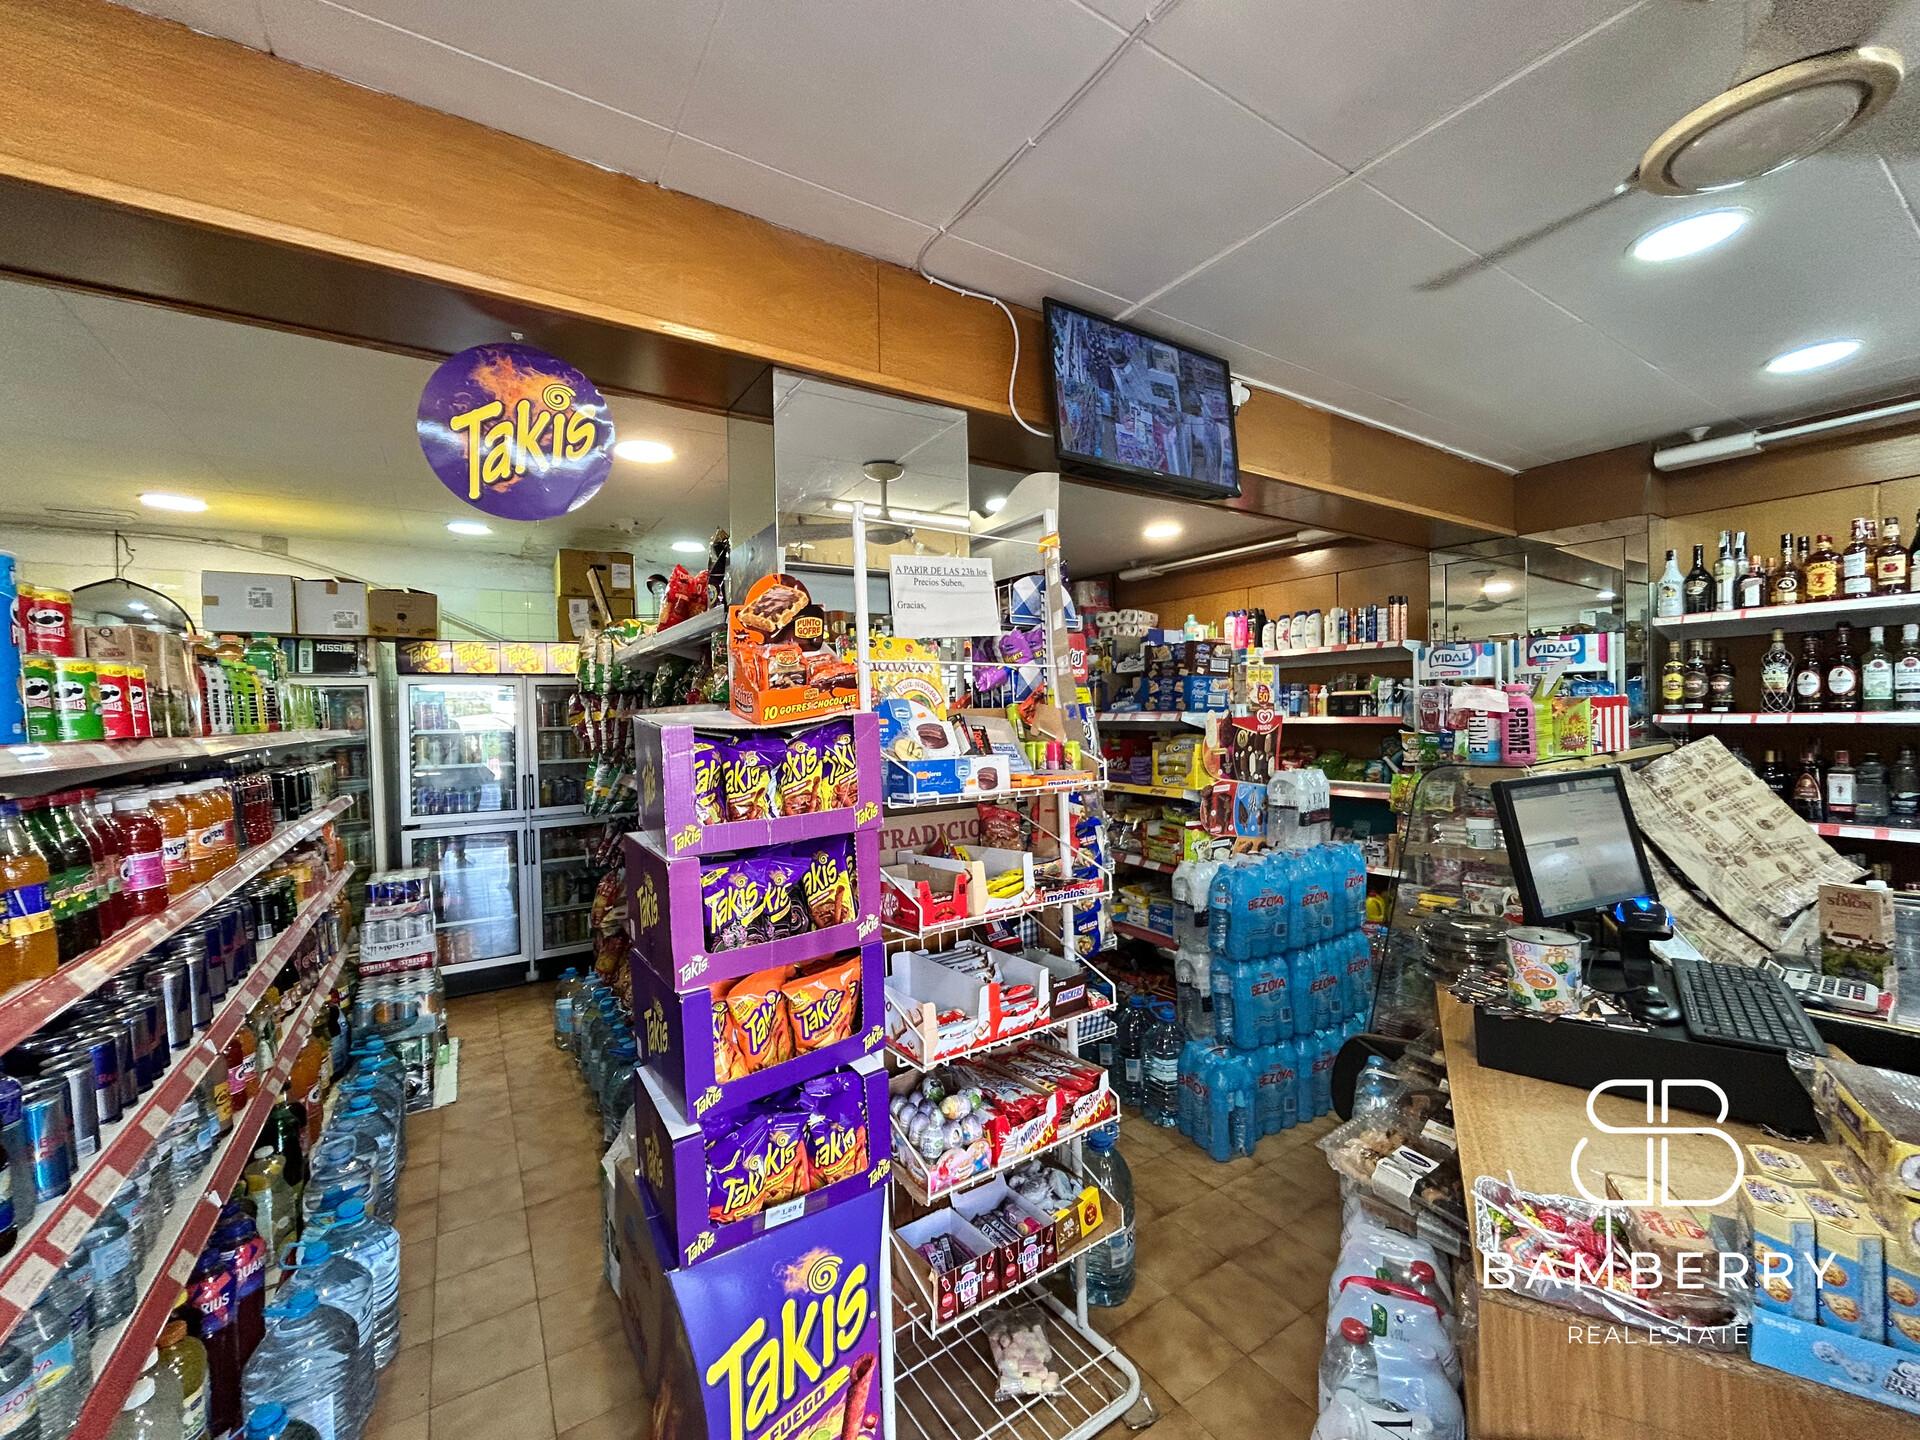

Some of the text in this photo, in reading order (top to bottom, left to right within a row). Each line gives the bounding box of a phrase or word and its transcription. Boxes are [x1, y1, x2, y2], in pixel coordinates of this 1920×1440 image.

[450, 383, 596, 500] Takis
[895, 566, 903, 575] A
[904, 566, 929, 575] PARIR
[930, 567, 942, 575] DE
[943, 567, 960, 575] LAS
[913, 578, 939, 587] Precios
[796, 618, 822, 627] PUNTO
[796, 626, 822, 636] GOFRE
[1434, 653, 1469, 663] VIDAL
[1533, 643, 1577, 656] VIDAL
[764, 694, 857, 720] 10 GOFRES CHOCOLATE
[855, 802, 880, 828] Takis
[672, 824, 702, 854] Takis
[704, 874, 758, 934] Takis
[1045, 887, 1087, 902] mentos
[1248, 895, 1285, 911] BEZOYA
[856, 914, 880, 941] Takis
[679, 955, 710, 986] Takis
[1058, 988, 1085, 1002] SNICKERS
[1251, 978, 1286, 996] BEZOYA
[796, 990, 844, 1038] Takis
[863, 1025, 885, 1053] Takis
[693, 1086, 723, 1119] Takis
[1020, 1119, 1039, 1146] Milky
[868, 1159, 891, 1188] Takis
[685, 1232, 716, 1265] Takis
[1018, 1244, 1045, 1263] dipper
[955, 1272, 985, 1292] dipper
[706, 1254, 868, 1440] Takis
[770, 1384, 827, 1440] FUEGO
